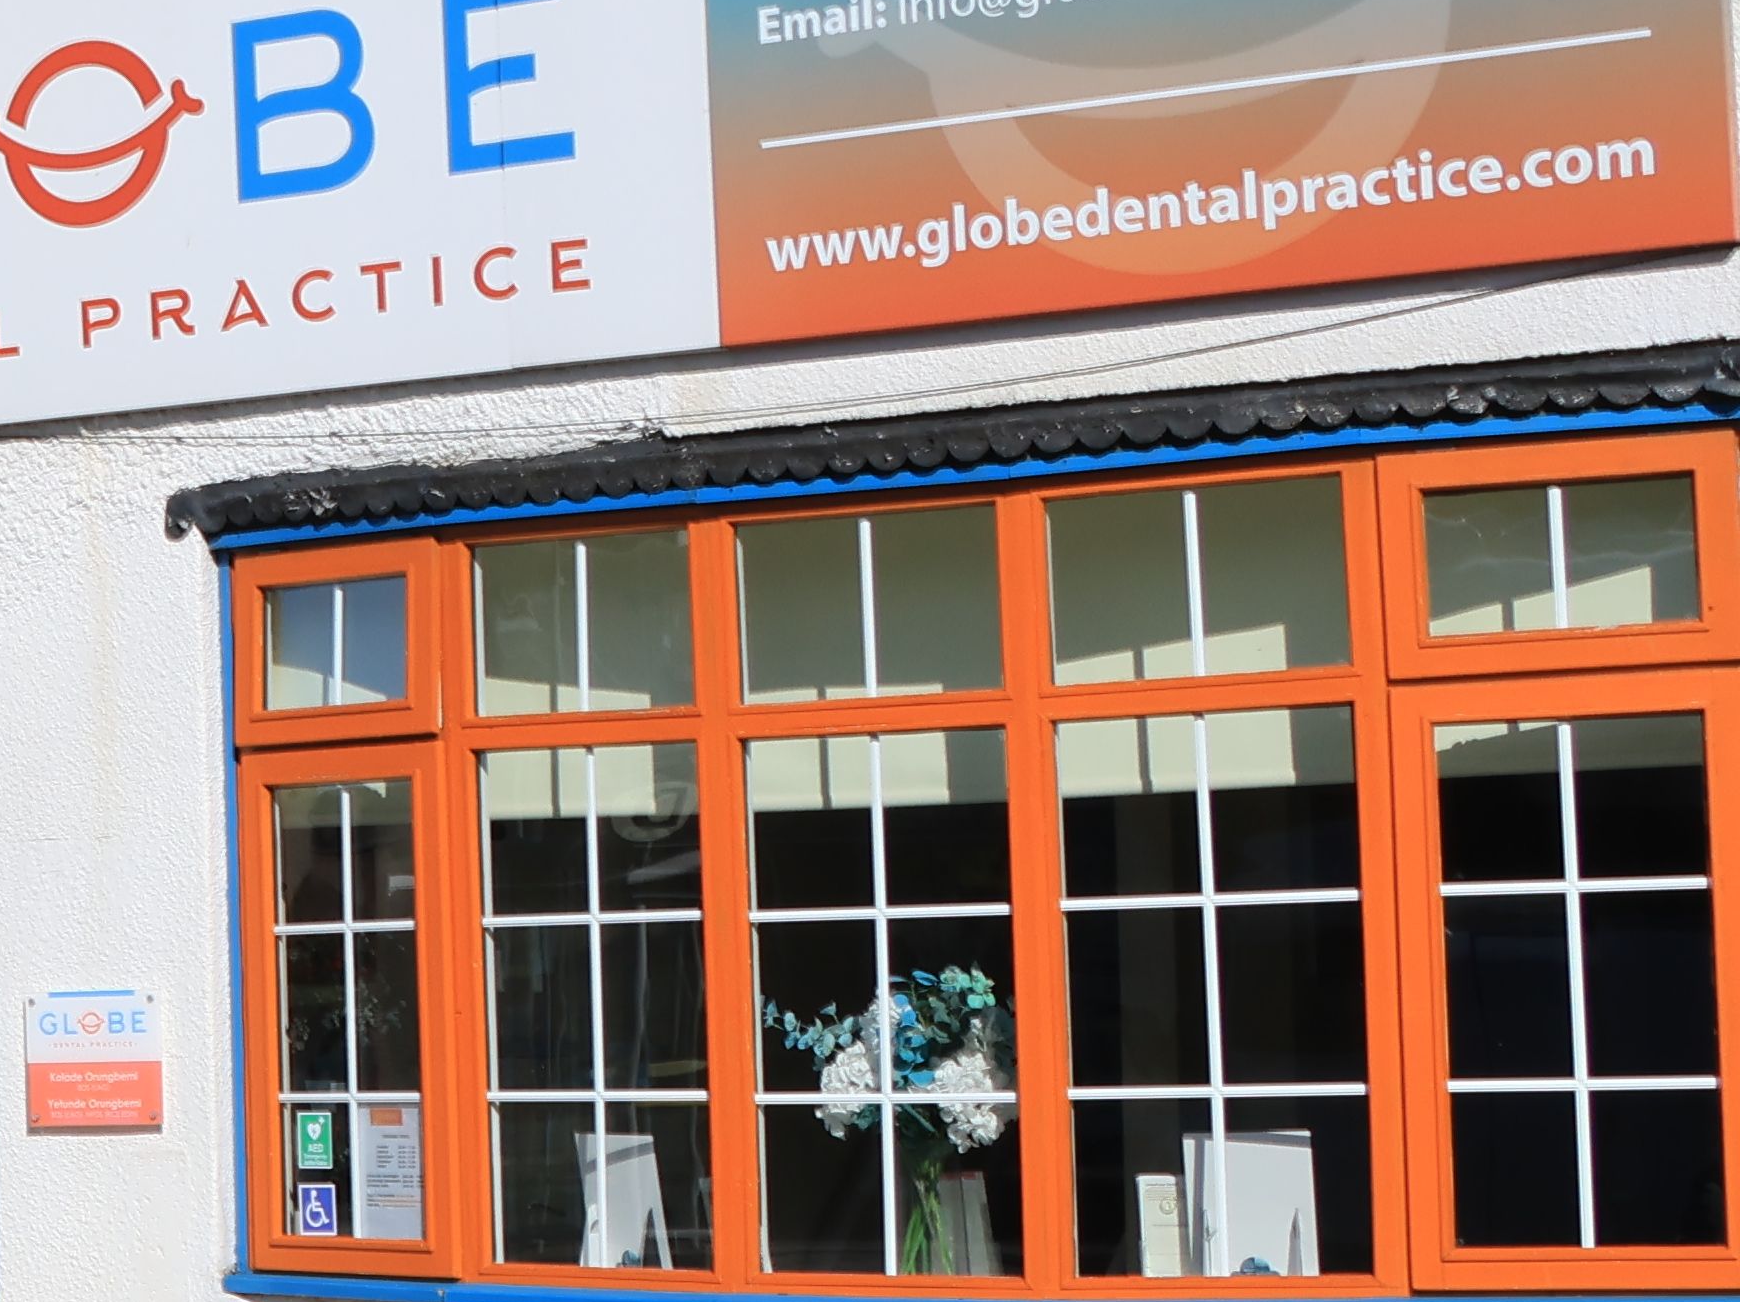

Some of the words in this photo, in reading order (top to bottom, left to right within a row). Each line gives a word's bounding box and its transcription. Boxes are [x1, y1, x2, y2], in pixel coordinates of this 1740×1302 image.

[765, 136, 1657, 273] www.globedentalpractice.com
[81, 238, 594, 348] PRACTICE
[39, 1010, 147, 1035] GLOBE
[90, 1040, 133, 1048] PRACTICE
[308, 1143, 324, 1153] AED
